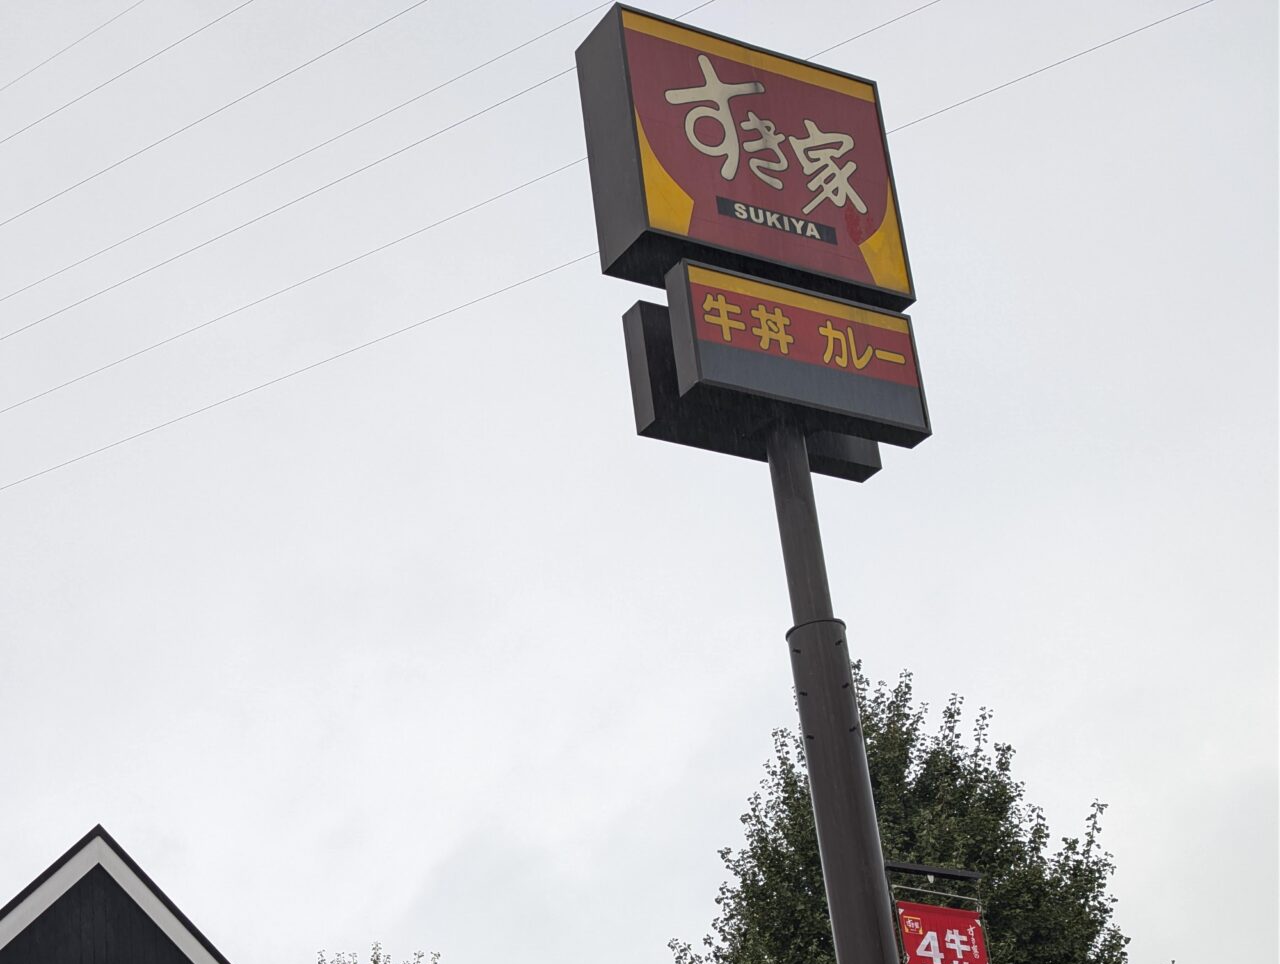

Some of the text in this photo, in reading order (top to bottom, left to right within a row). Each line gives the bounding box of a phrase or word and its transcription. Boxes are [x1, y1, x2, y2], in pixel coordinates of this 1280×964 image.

[664, 53, 869, 216] すき家
[733, 202, 821, 240] SUKIYA
[701, 293, 907, 370] 牛丼 カレー
